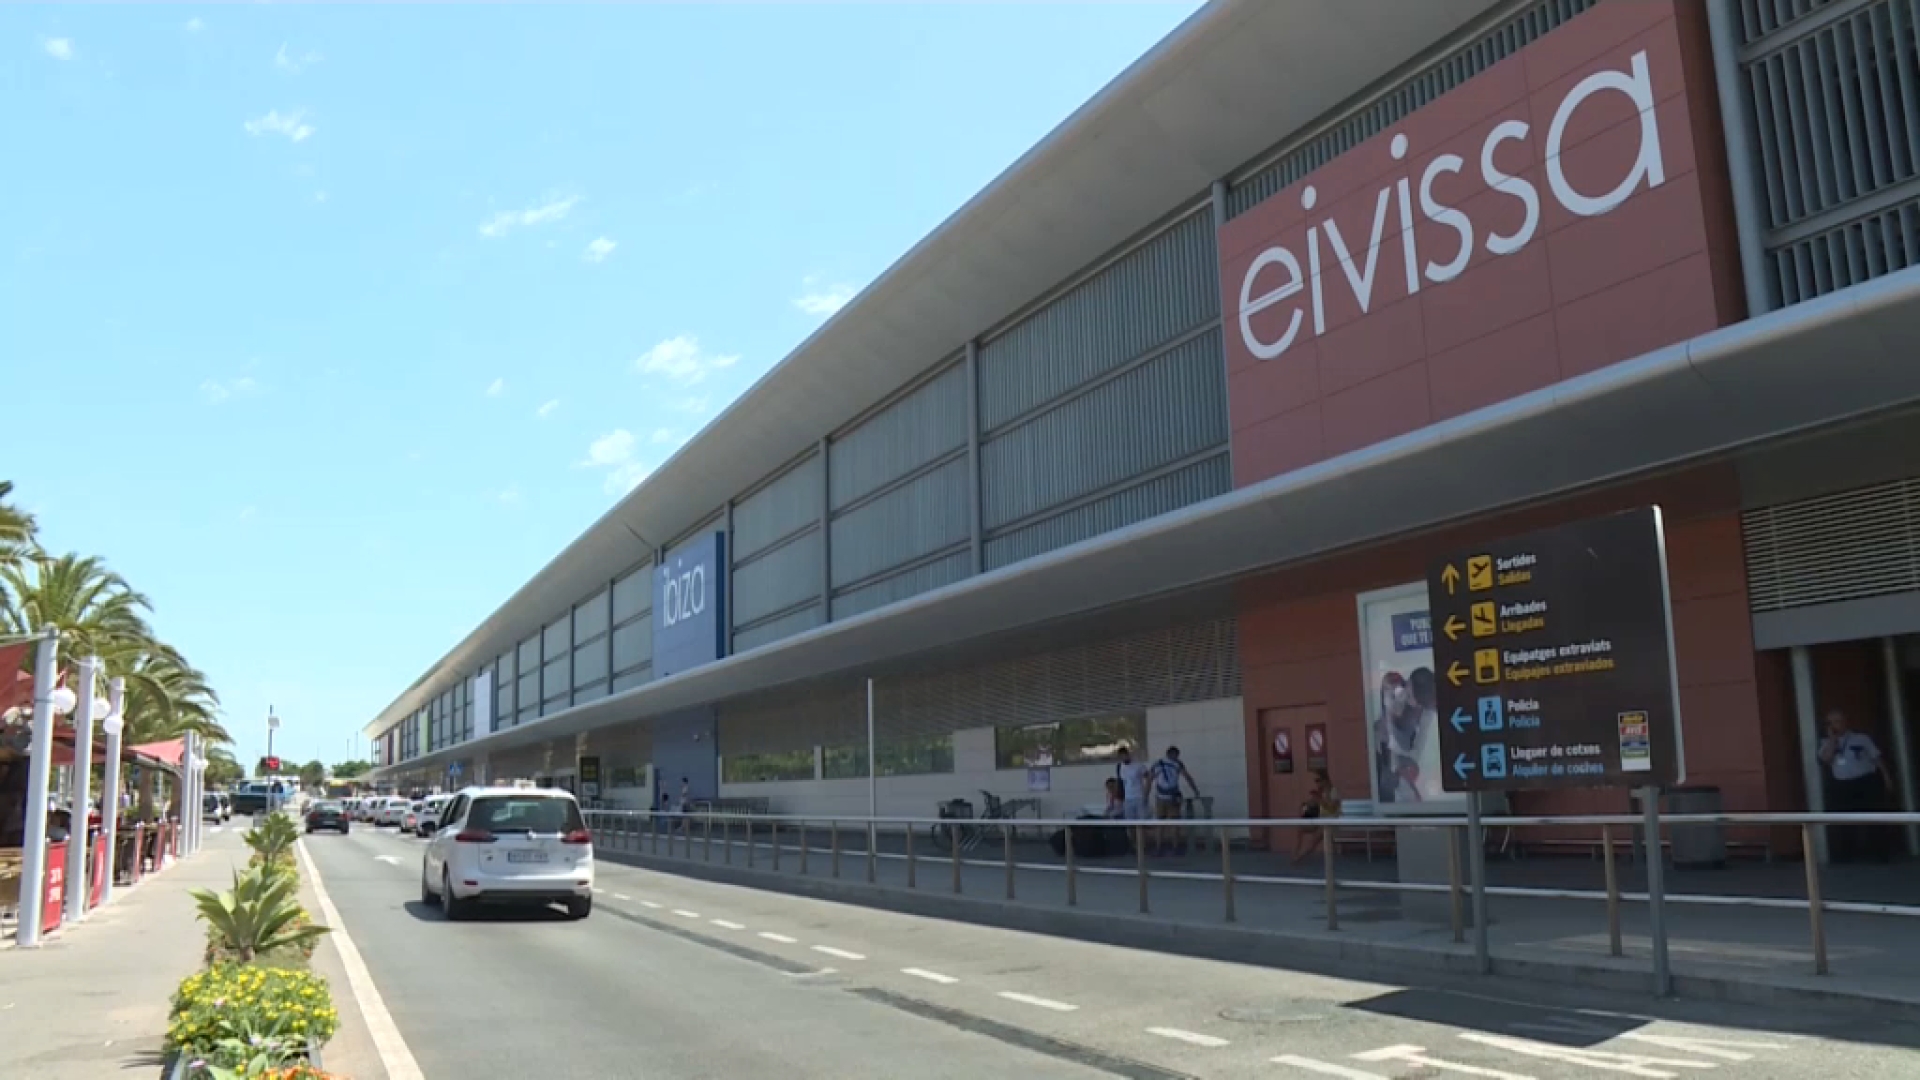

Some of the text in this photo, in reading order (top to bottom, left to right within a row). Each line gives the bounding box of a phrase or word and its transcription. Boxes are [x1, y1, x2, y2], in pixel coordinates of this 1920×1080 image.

[1239, 49, 1666, 361] eivissa
[1496, 553, 1537, 571] Sortides
[1498, 570, 1531, 585] Salidas
[663, 558, 705, 628] ibiza
[1500, 600, 1547, 617] Arribades
[1501, 616, 1545, 632] Llegadas
[1503, 639, 1612, 665] Equipatges extraviats
[1505, 657, 1614, 681] Equipajes extraviados
[1507, 697, 1540, 712] Policia
[1510, 743, 1601, 762] Lloguer de cotxes
[1512, 760, 1605, 778] Alquiler de coches
